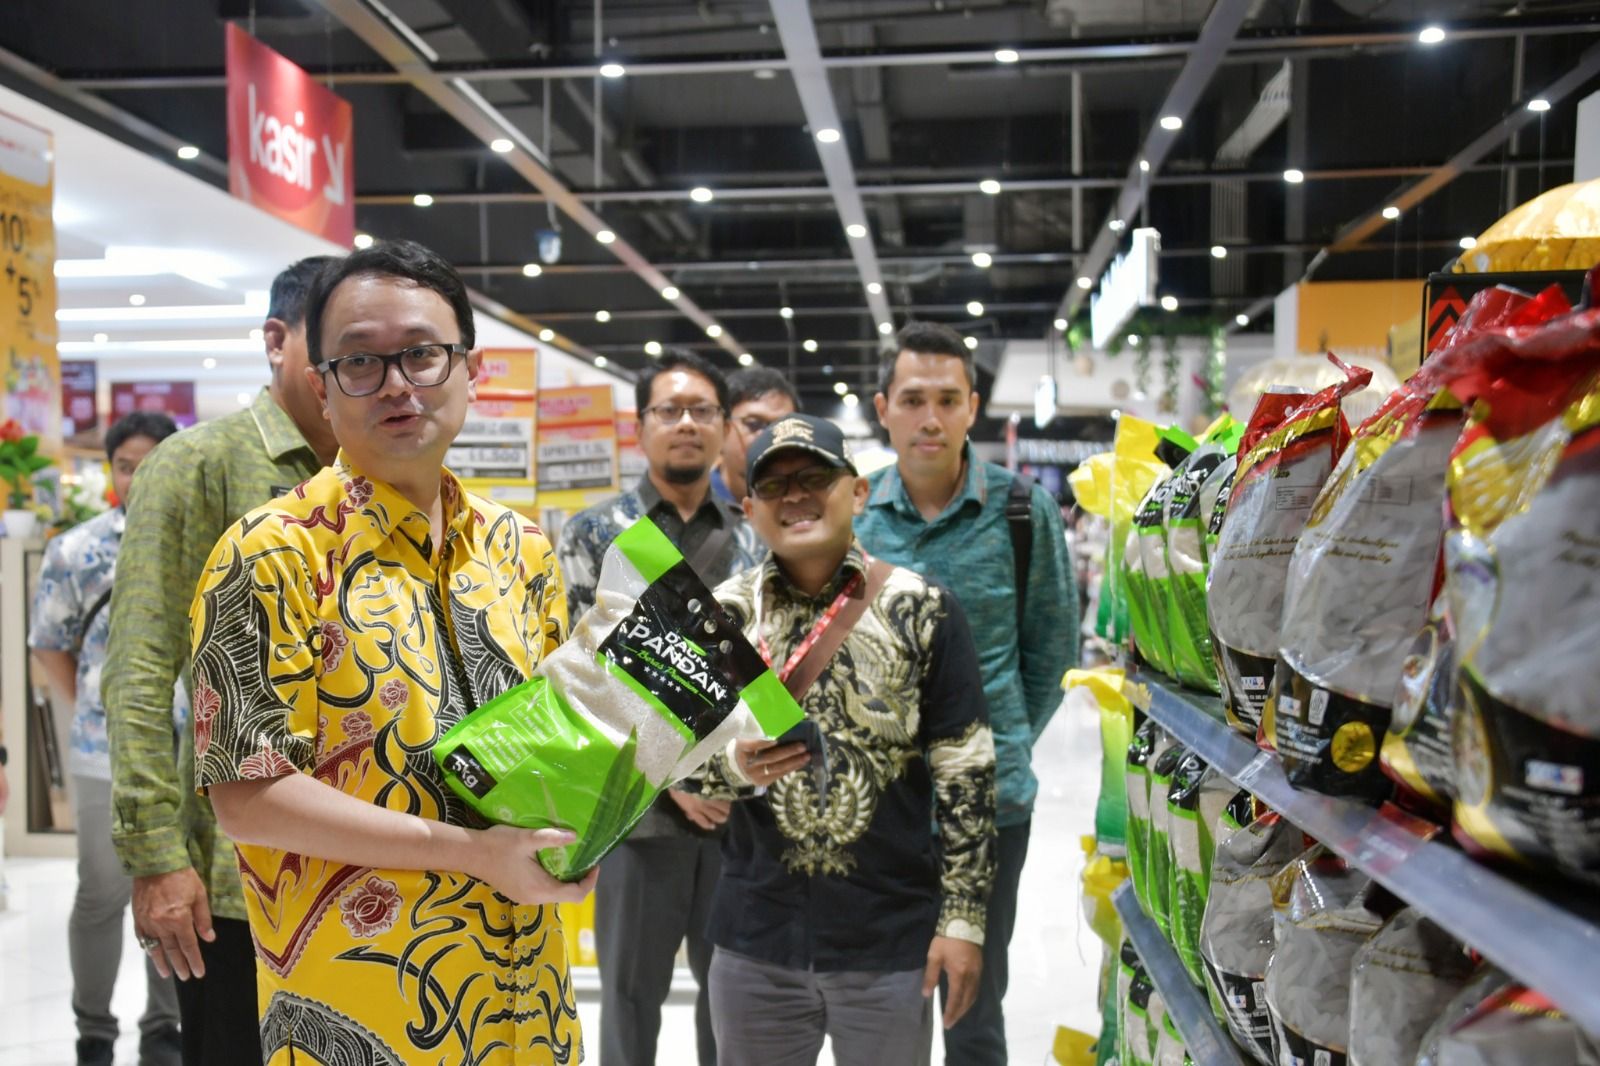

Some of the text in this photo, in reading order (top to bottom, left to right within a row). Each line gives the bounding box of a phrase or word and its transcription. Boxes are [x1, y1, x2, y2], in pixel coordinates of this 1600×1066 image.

[248, 82, 316, 191] kasir
[627, 622, 727, 701] PANDAN
[664, 631, 709, 670] DAUN
[453, 757, 479, 788] 5kg
